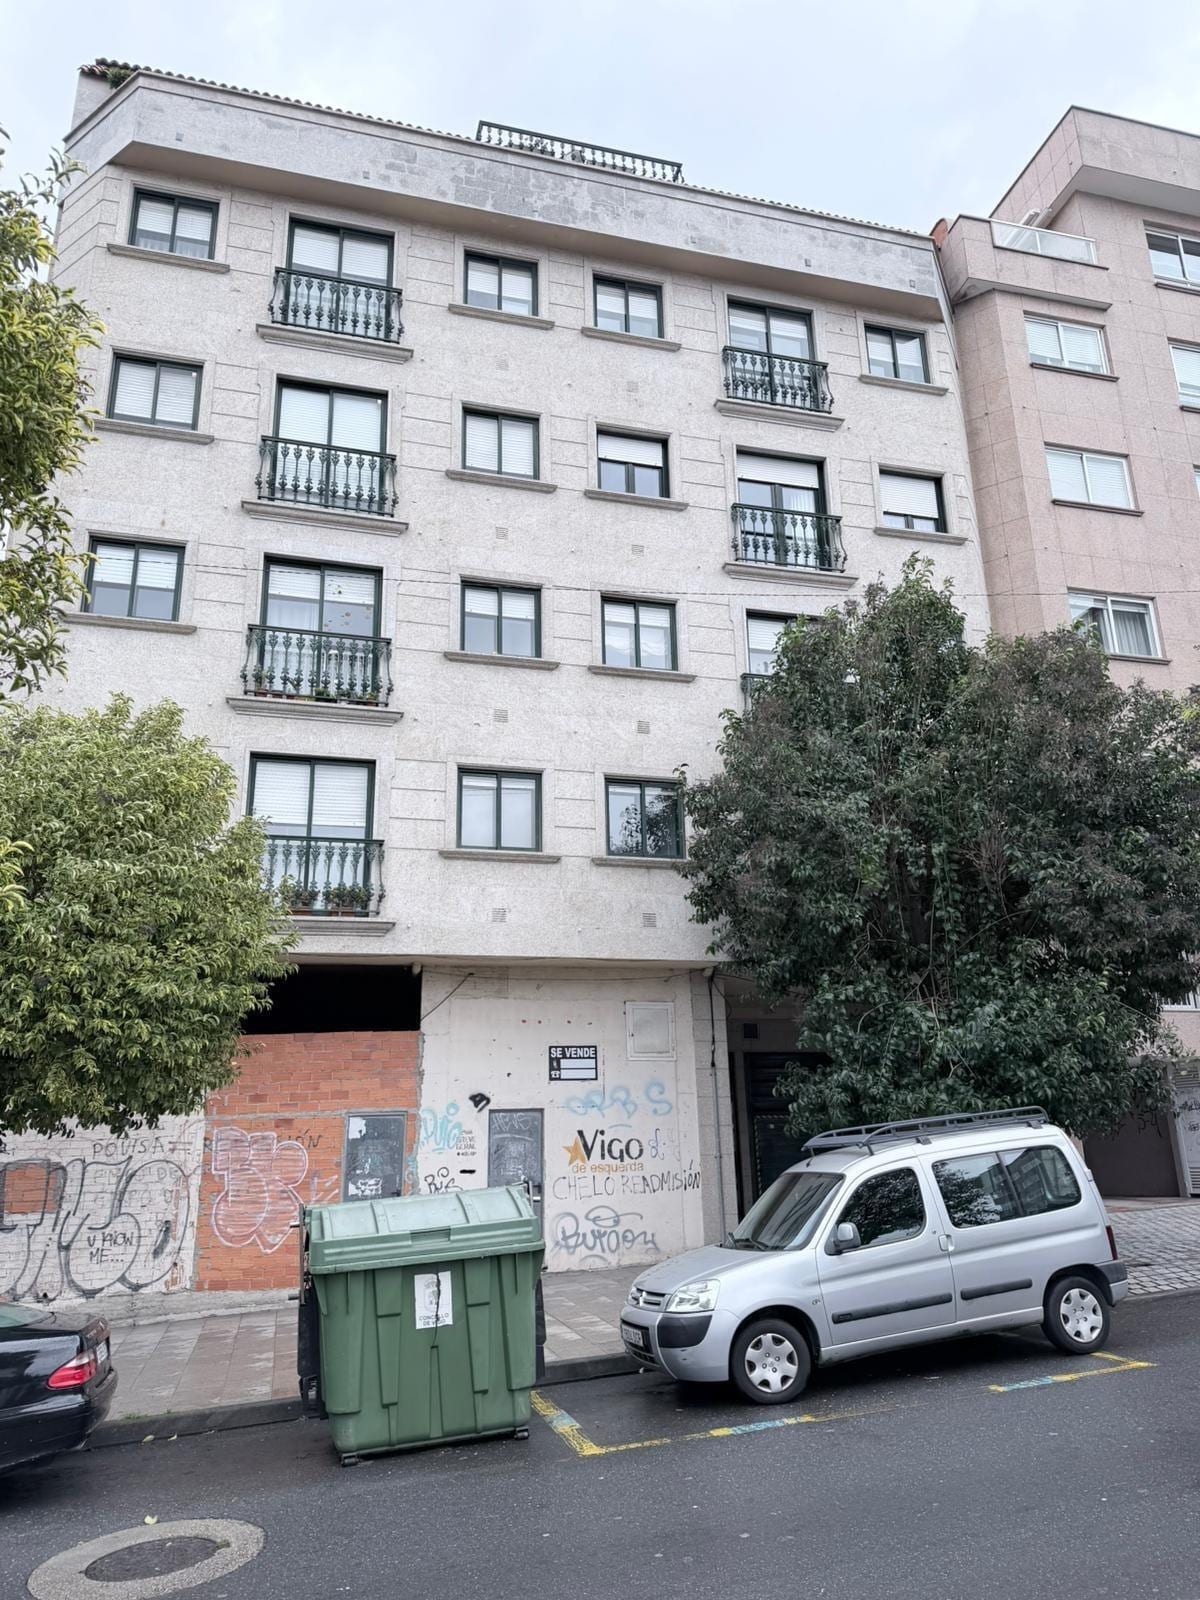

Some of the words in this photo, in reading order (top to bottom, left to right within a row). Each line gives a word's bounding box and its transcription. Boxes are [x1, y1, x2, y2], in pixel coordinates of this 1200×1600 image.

[550, 1047, 563, 1058] SE
[565, 1047, 596, 1058] VENDE
[571, 1162, 586, 1174] de
[590, 1161, 645, 1175] esquerda
[553, 1174, 615, 1200] CHELO
